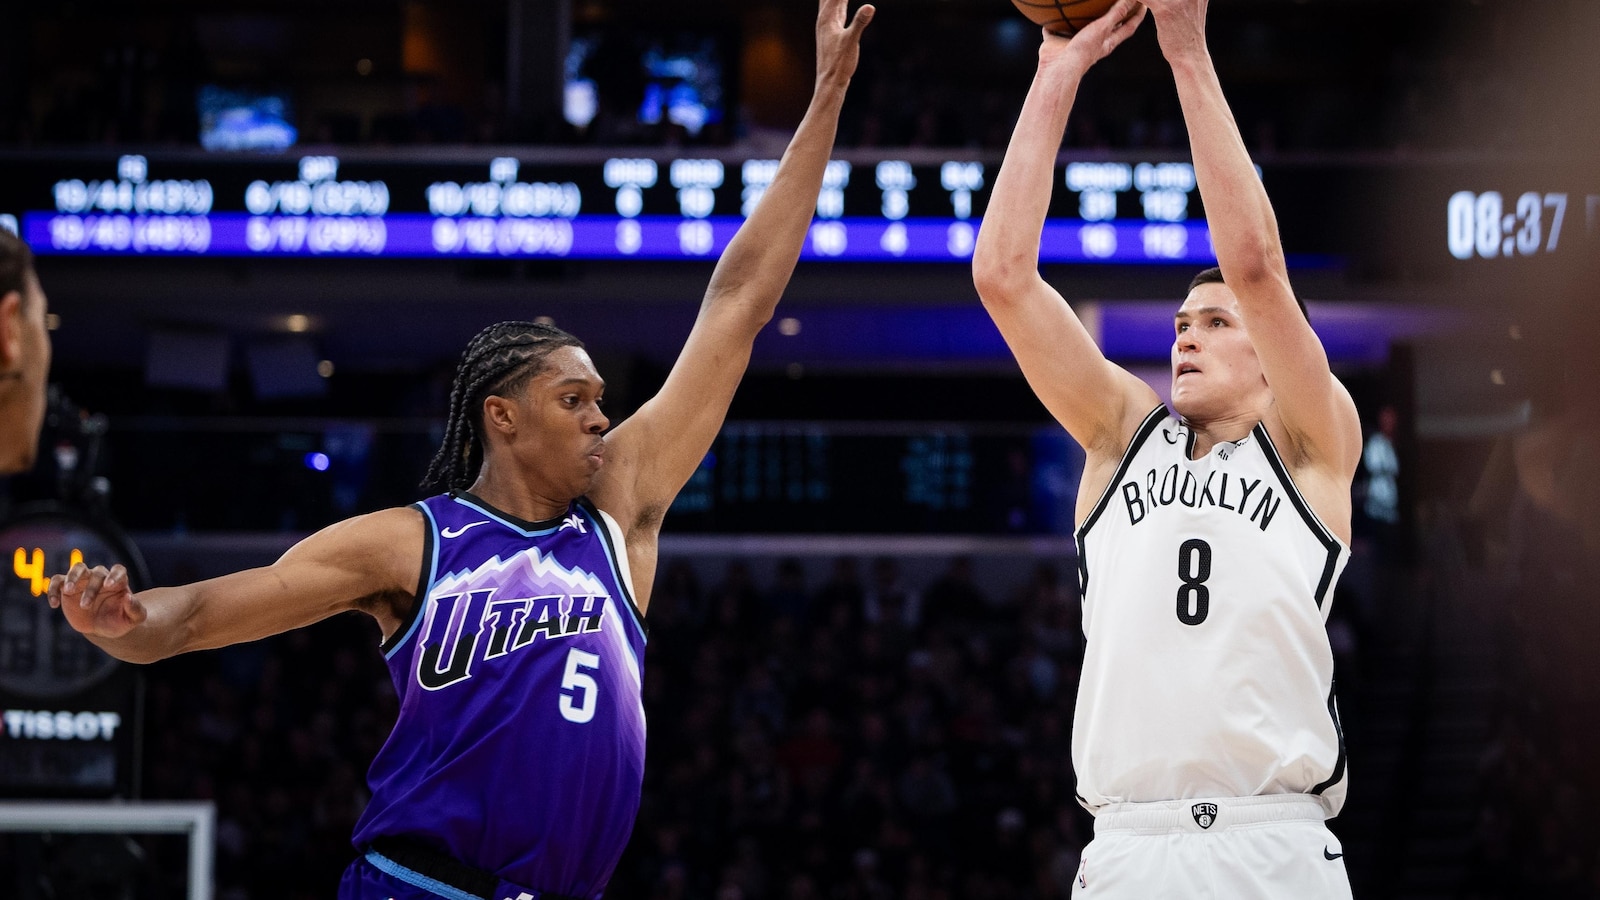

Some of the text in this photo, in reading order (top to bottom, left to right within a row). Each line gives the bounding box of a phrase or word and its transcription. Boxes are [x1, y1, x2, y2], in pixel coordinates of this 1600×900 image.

[1447, 190, 1568, 260] 08:37
[1122, 463, 1281, 532] BROOKLYN
[1176, 538, 1212, 626] 8
[417, 587, 611, 691] UTAH
[559, 647, 600, 724] 5
[4, 710, 121, 741] TISSOT
[1193, 805, 1216, 816] NETS
